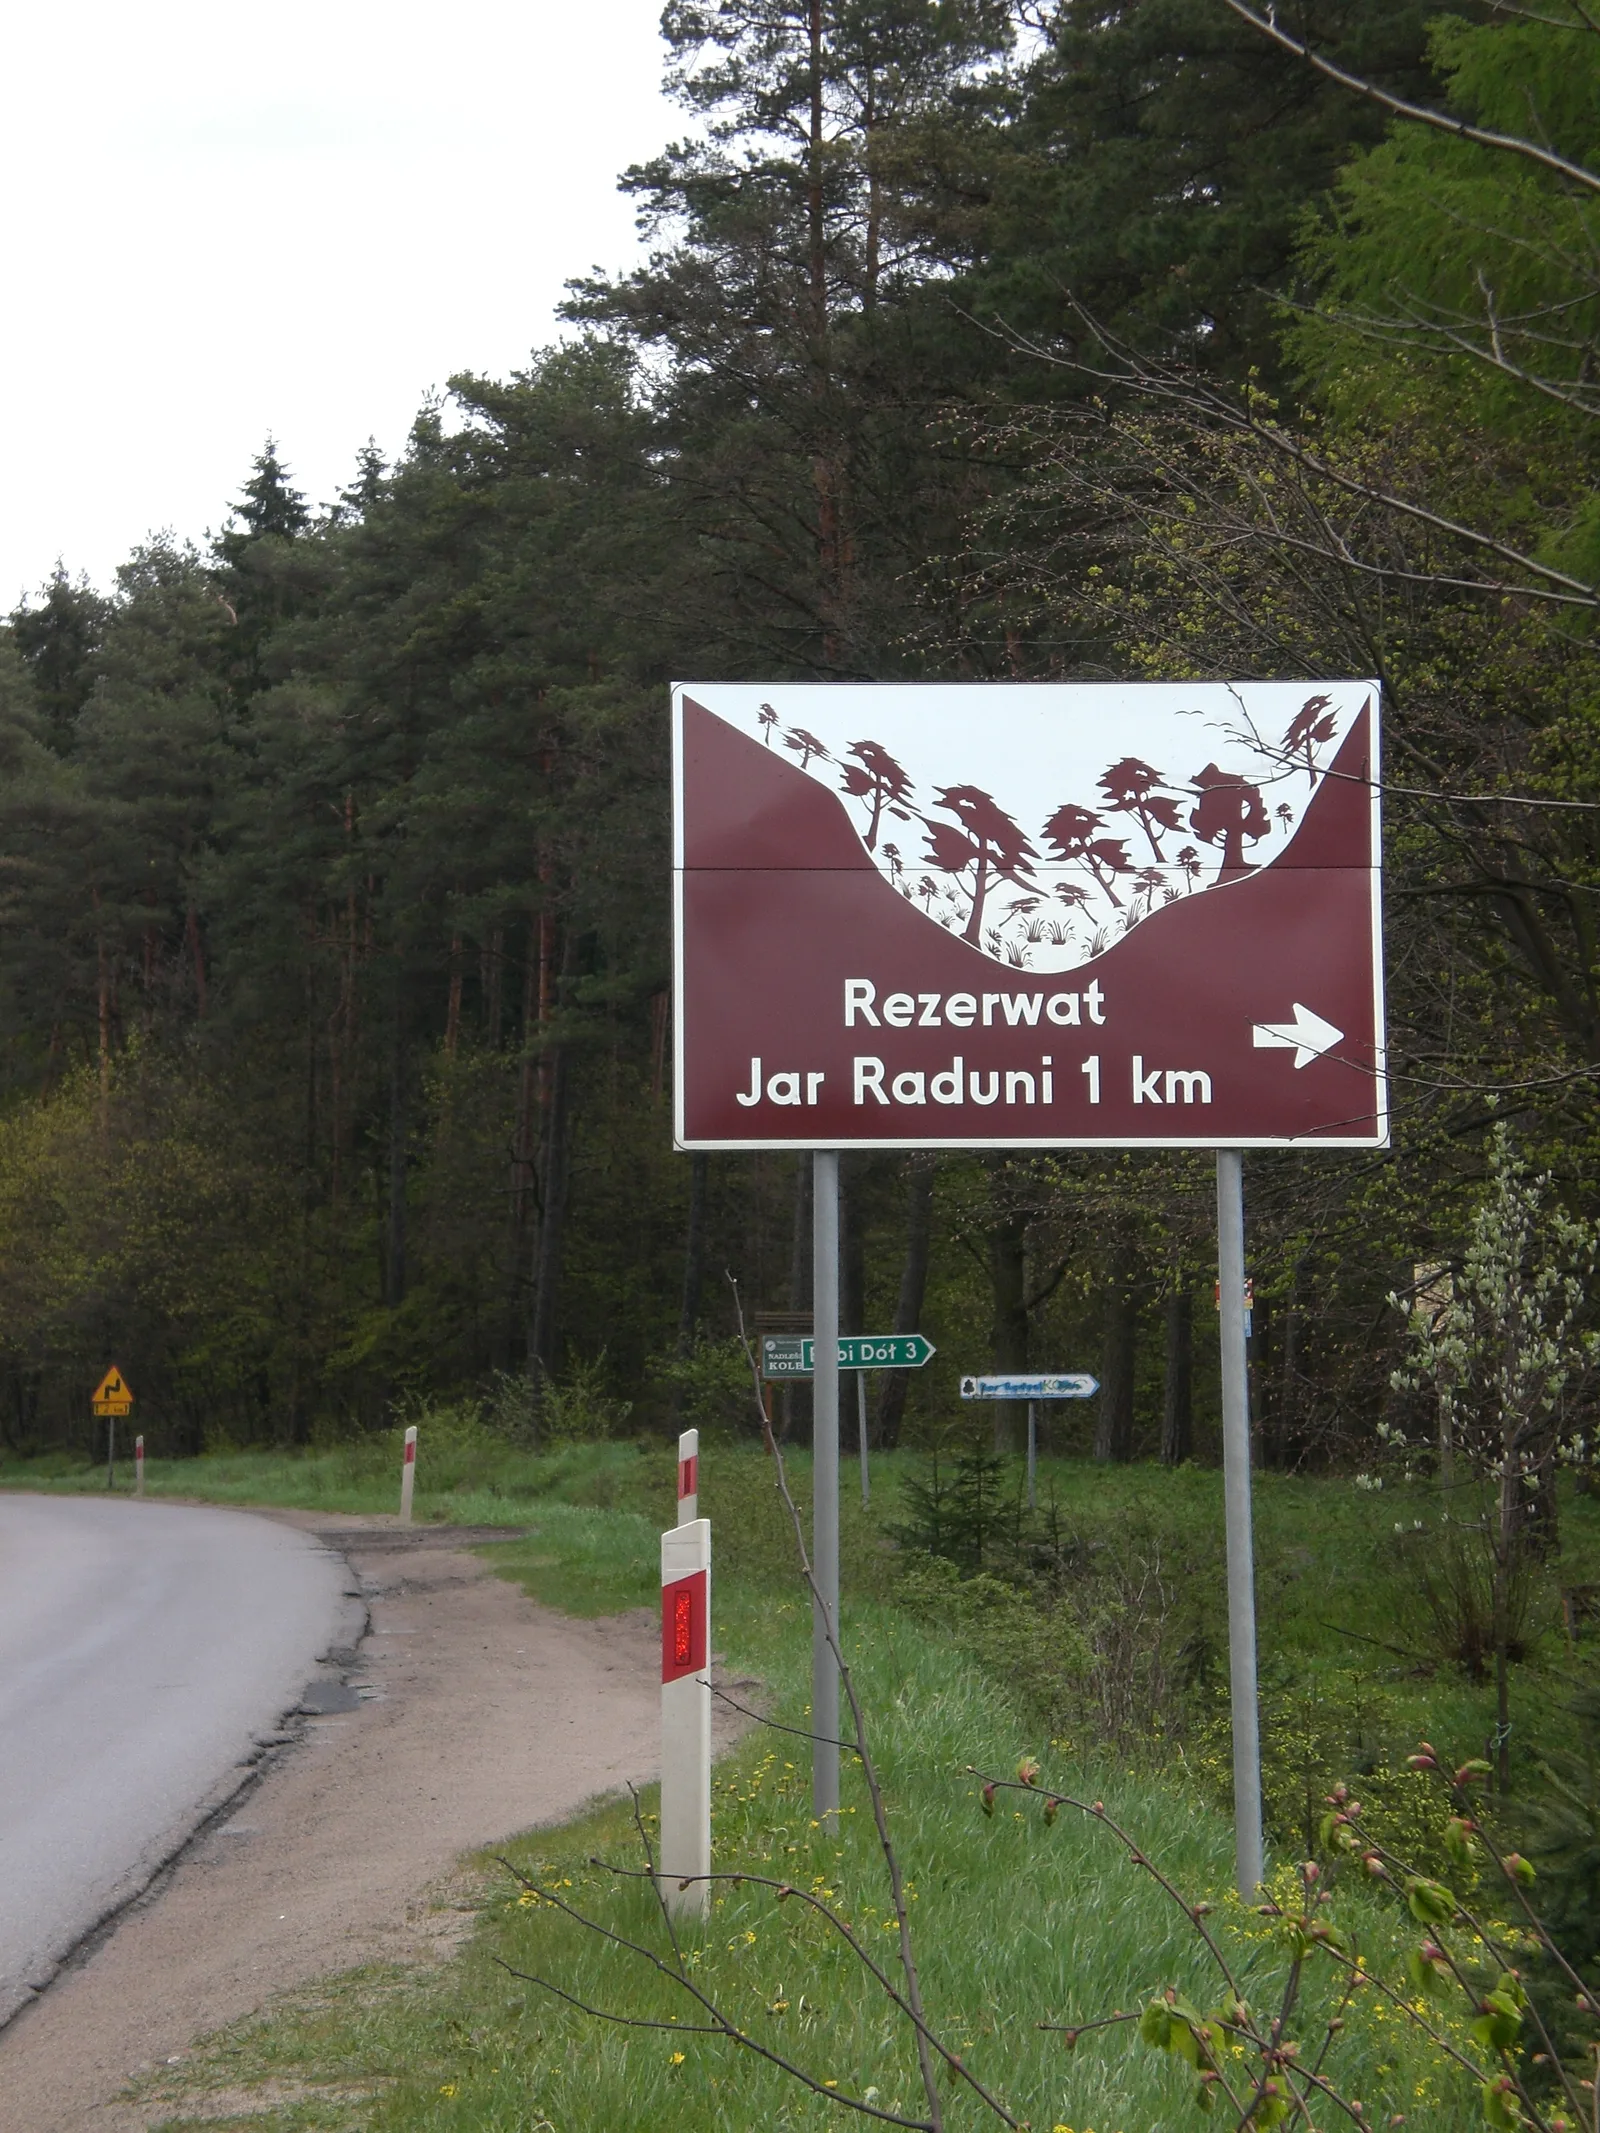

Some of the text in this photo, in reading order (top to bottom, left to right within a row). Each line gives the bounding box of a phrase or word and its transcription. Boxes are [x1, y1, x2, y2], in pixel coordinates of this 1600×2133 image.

[844, 978, 1107, 1028] Rezerwat
[735, 1055, 1212, 1107] Jar Raduni 1 km
[861, 1343, 897, 1361] Dół
[905, 1342, 917, 1359] 3
